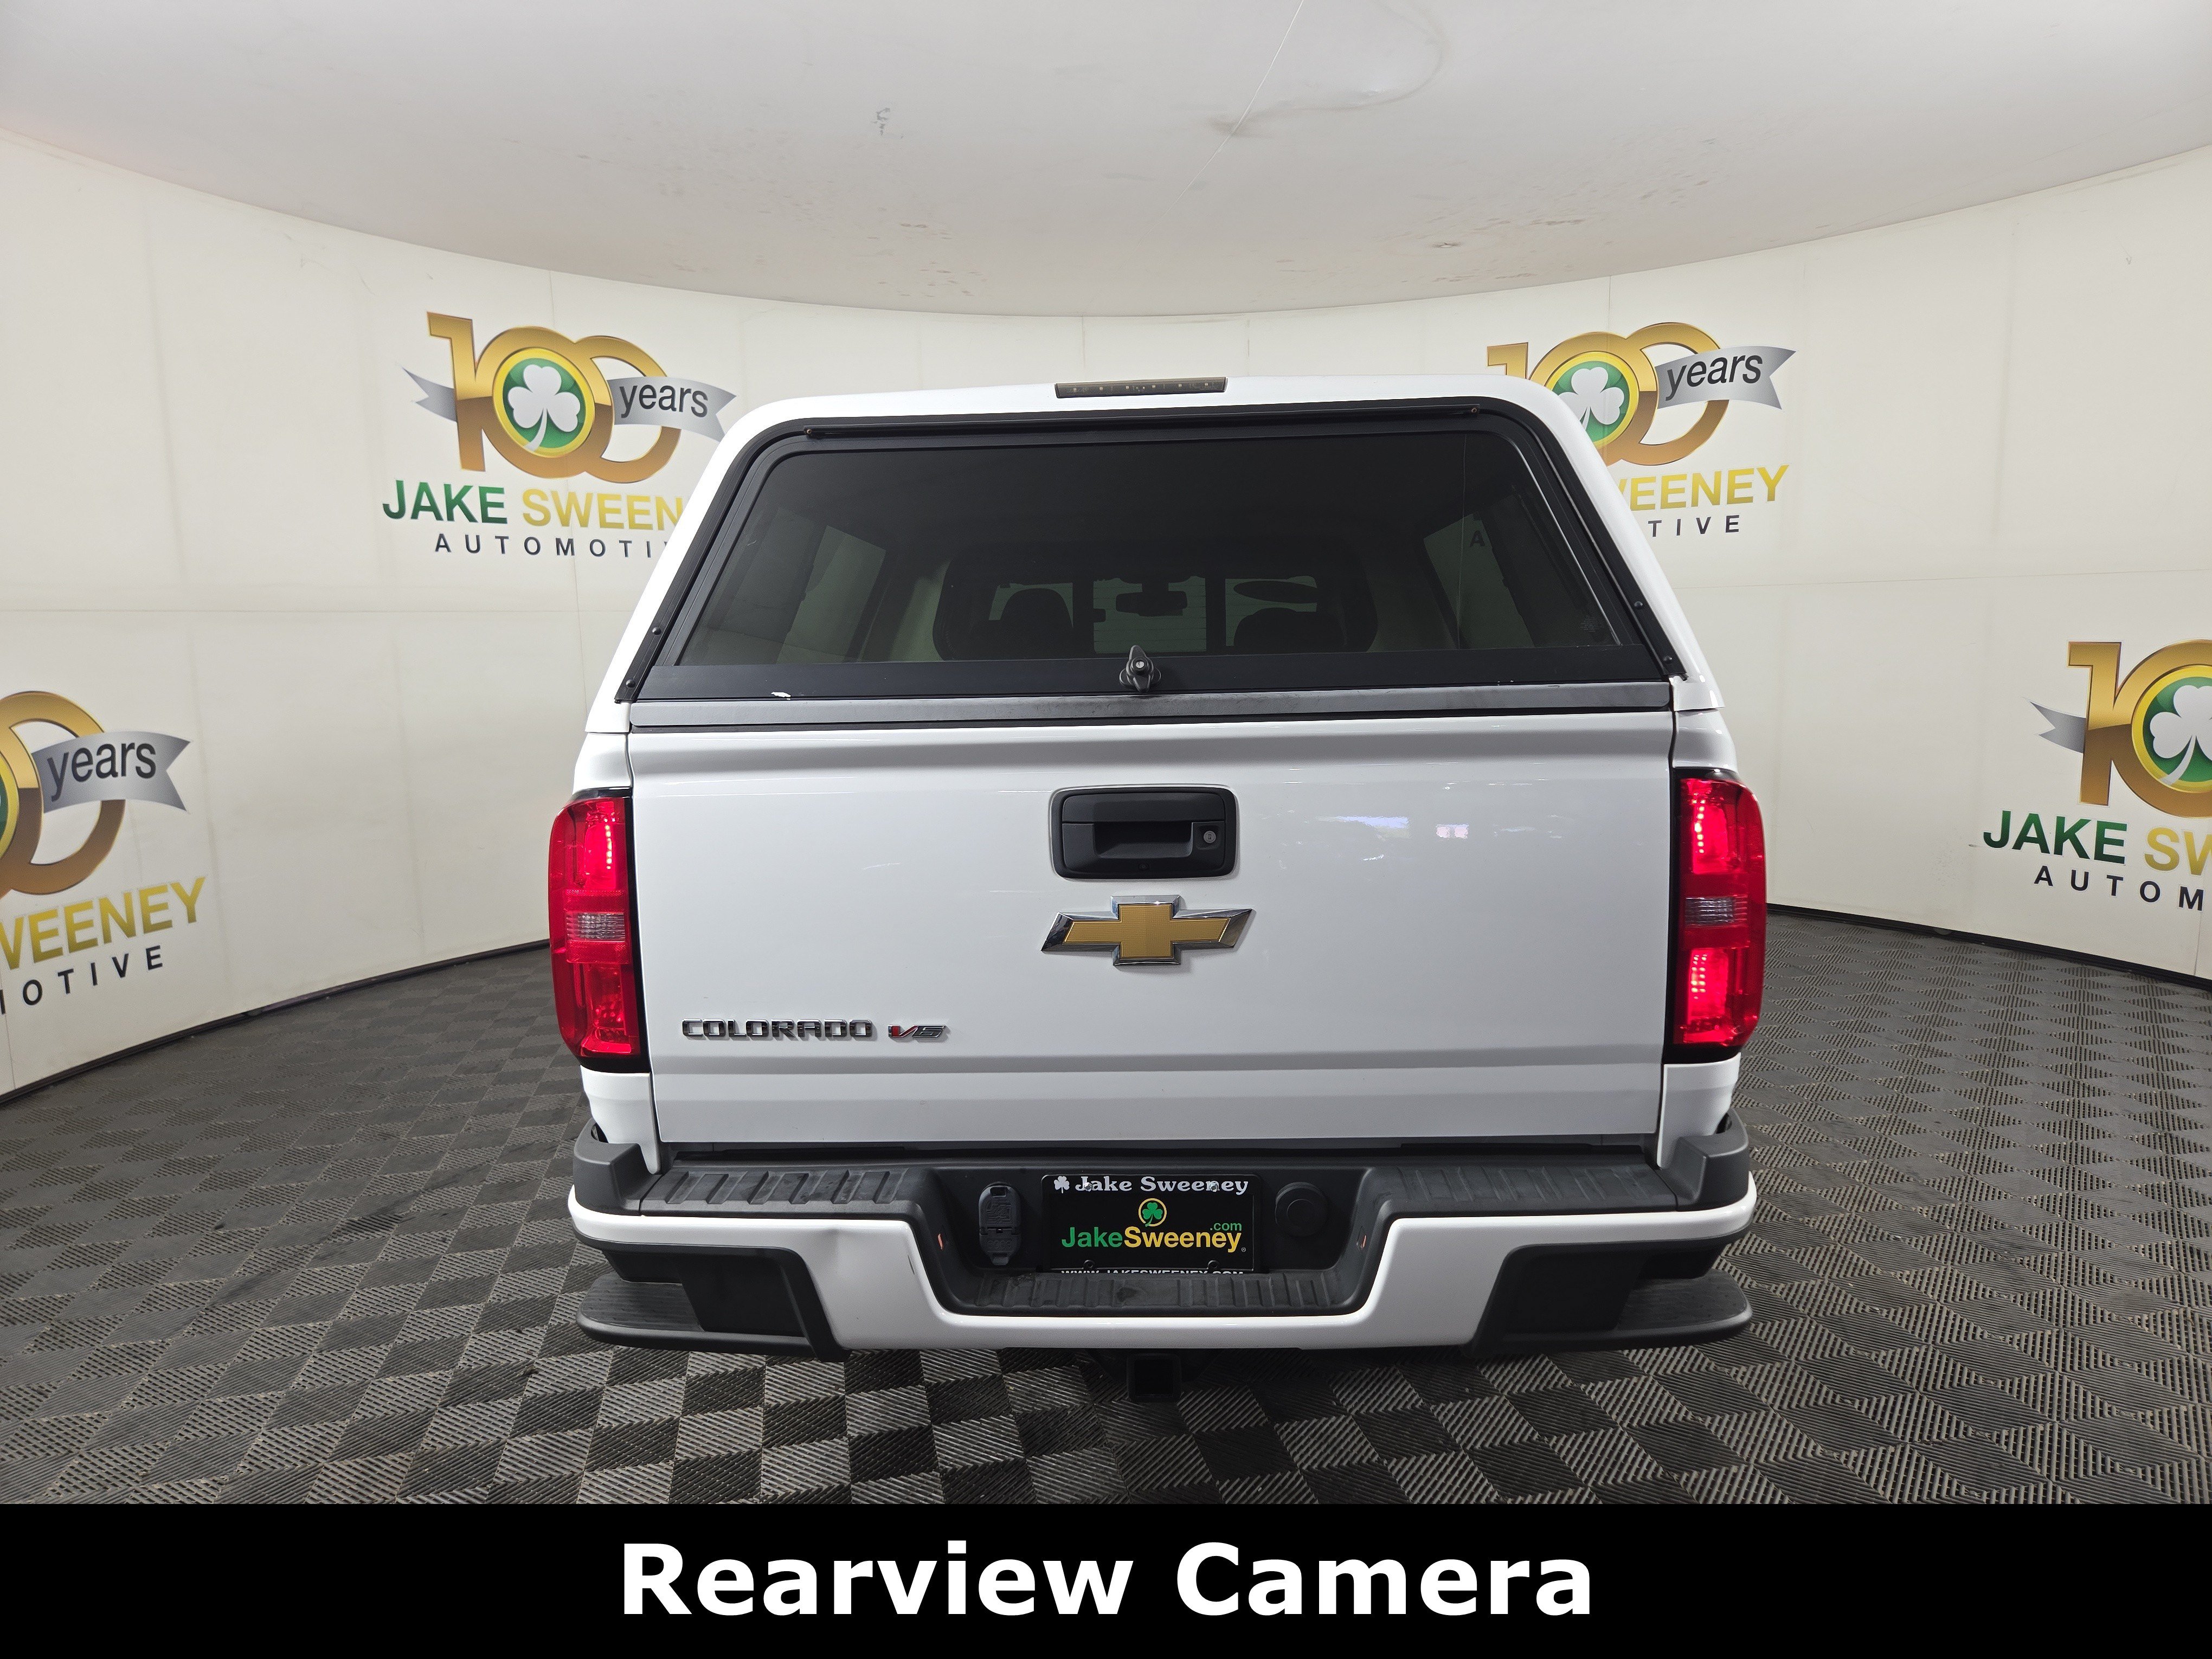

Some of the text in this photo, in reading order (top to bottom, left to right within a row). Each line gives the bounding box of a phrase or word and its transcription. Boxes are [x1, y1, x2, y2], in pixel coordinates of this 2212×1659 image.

[1665, 355, 1763, 402] years
[619, 384, 709, 419] years
[383, 479, 509, 524] JAKE
[1618, 464, 1790, 511] EENEY
[434, 533, 668, 557] AUTOMOTI
[47, 741, 157, 801] years
[1983, 810, 2127, 865] JAKE
[681, 1018, 946, 1038] COLORADO V6
[1075, 1175, 1133, 1192] Jake
[1062, 1226, 1242, 1253] JakeSweeney
[1210, 1223, 1242, 1231] .com
